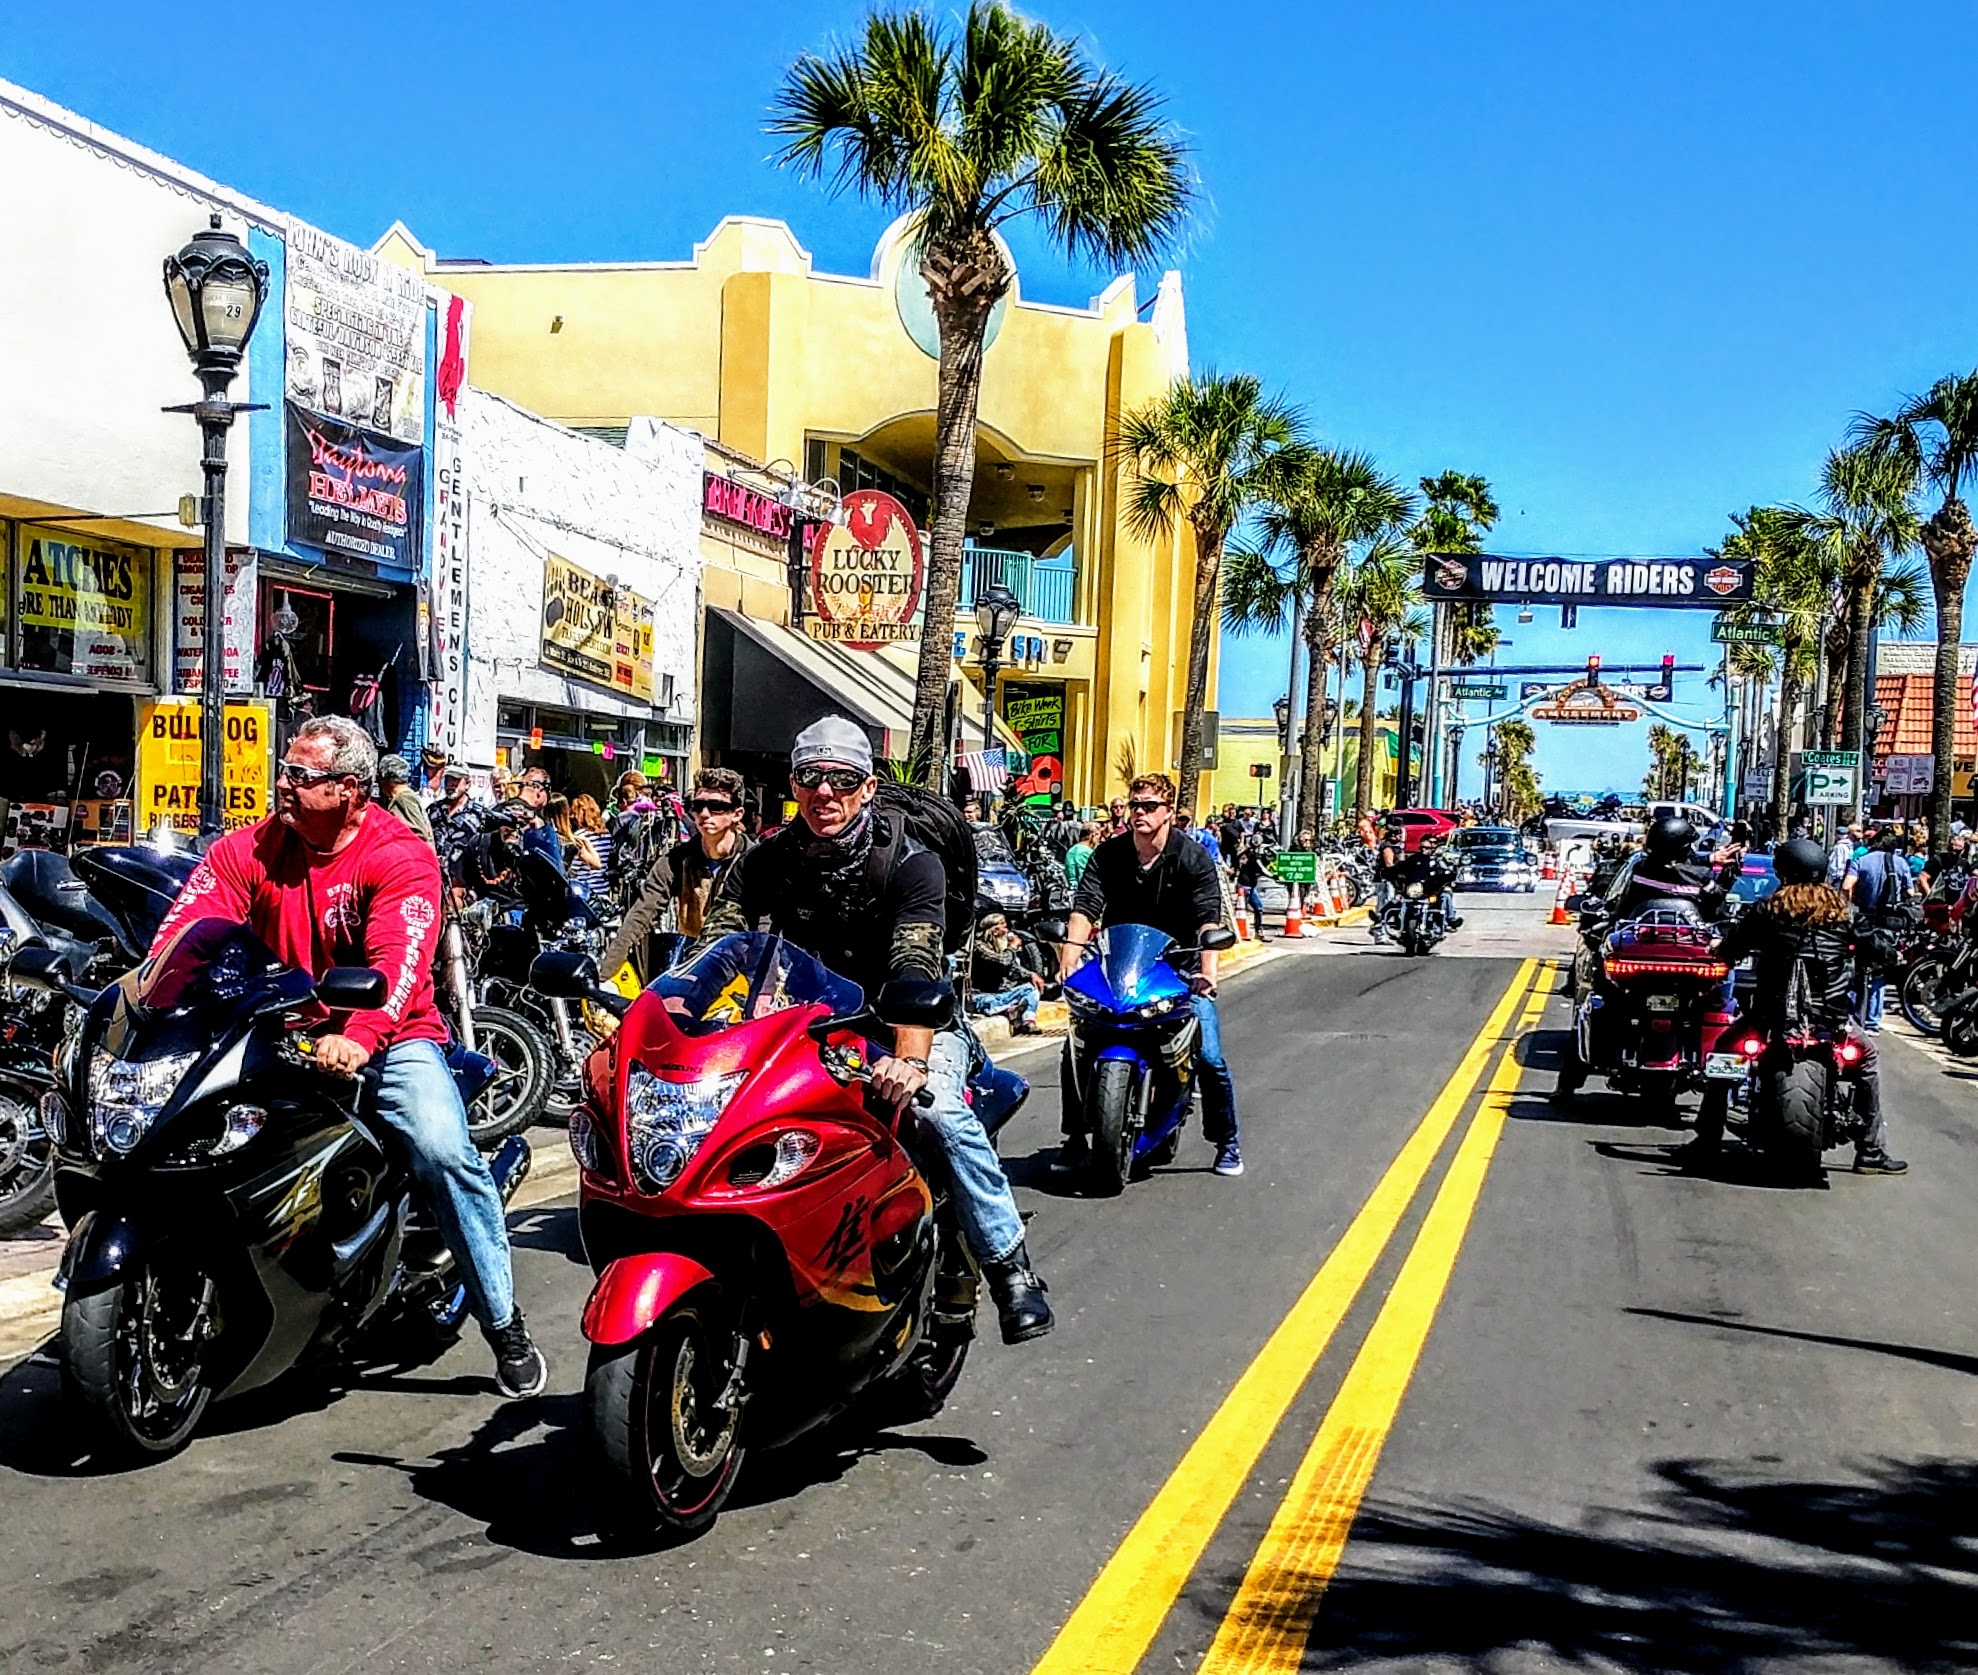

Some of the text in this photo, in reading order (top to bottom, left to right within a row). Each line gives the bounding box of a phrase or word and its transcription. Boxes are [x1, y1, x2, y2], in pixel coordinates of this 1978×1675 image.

[227, 304, 241, 318] 29
[309, 470, 407, 525] HELMETS
[325, 530, 396, 560] AUTHORIZED DEALER
[833, 549, 901, 570] LUCKY
[817, 573, 915, 594] ROOSTER
[1481, 561, 1597, 594] WELCOME
[1606, 564, 1695, 595] RIDERS
[813, 622, 918, 640] PUB & EATERY
[1716, 625, 1771, 640] Atlantic
[1455, 687, 1492, 698] Atlantic
[1010, 700, 1032, 718] Bike
[1537, 709, 1632, 722] AMUSEMENT
[153, 714, 258, 741] BULOG
[1013, 712, 1058, 732] T-Shirts
[1027, 734, 1056, 752] FOR
[1807, 752, 1841, 764] Coates
[154, 784, 255, 810] PATES
[149, 812, 201, 829] BIGGES
